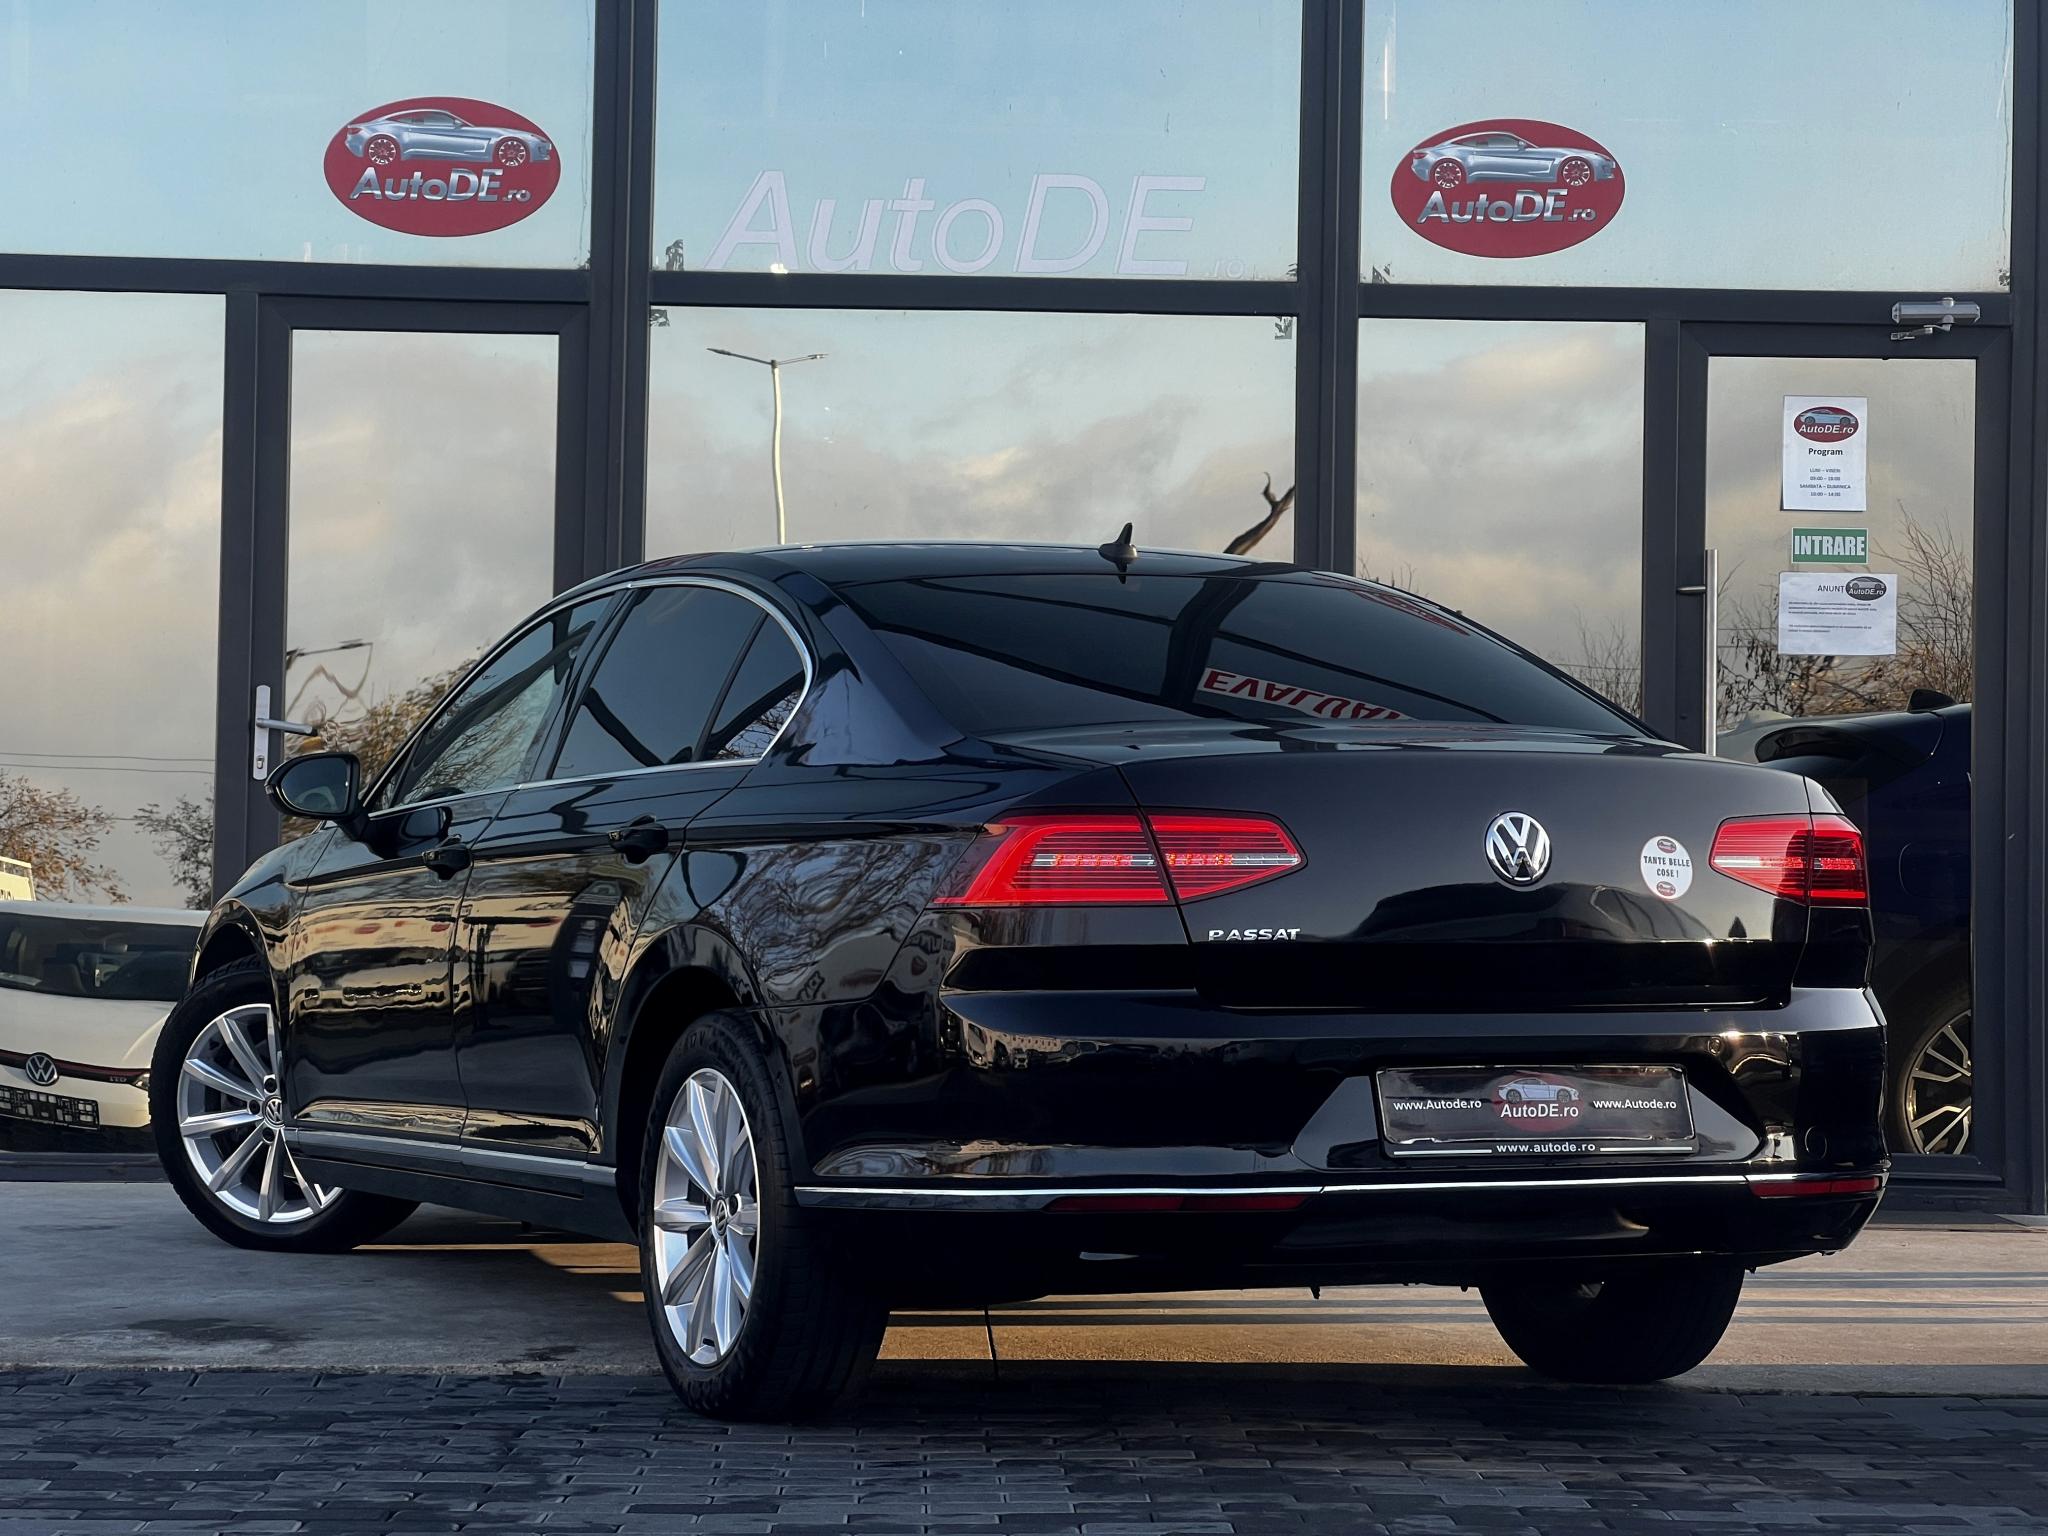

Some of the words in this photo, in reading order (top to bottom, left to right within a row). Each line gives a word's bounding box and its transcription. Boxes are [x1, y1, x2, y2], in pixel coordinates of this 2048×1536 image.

[1798, 424, 1854, 434] AutoDE.ro
[1808, 448, 1843, 457] Program
[1794, 535, 1865, 556] INTRARE
[1643, 855, 1667, 865] TANTE
[1668, 857, 1690, 867] BELLE
[1656, 868, 1674, 877] COSE
[1208, 928, 1300, 941] PASSAT
[1393, 1098, 1482, 1111] www.Autode.ro
[1593, 1098, 1677, 1110] www.Autode.ro
[1500, 1103, 1579, 1118] AutoDE.ro
[1496, 1142, 1596, 1153] www.autode.ro
